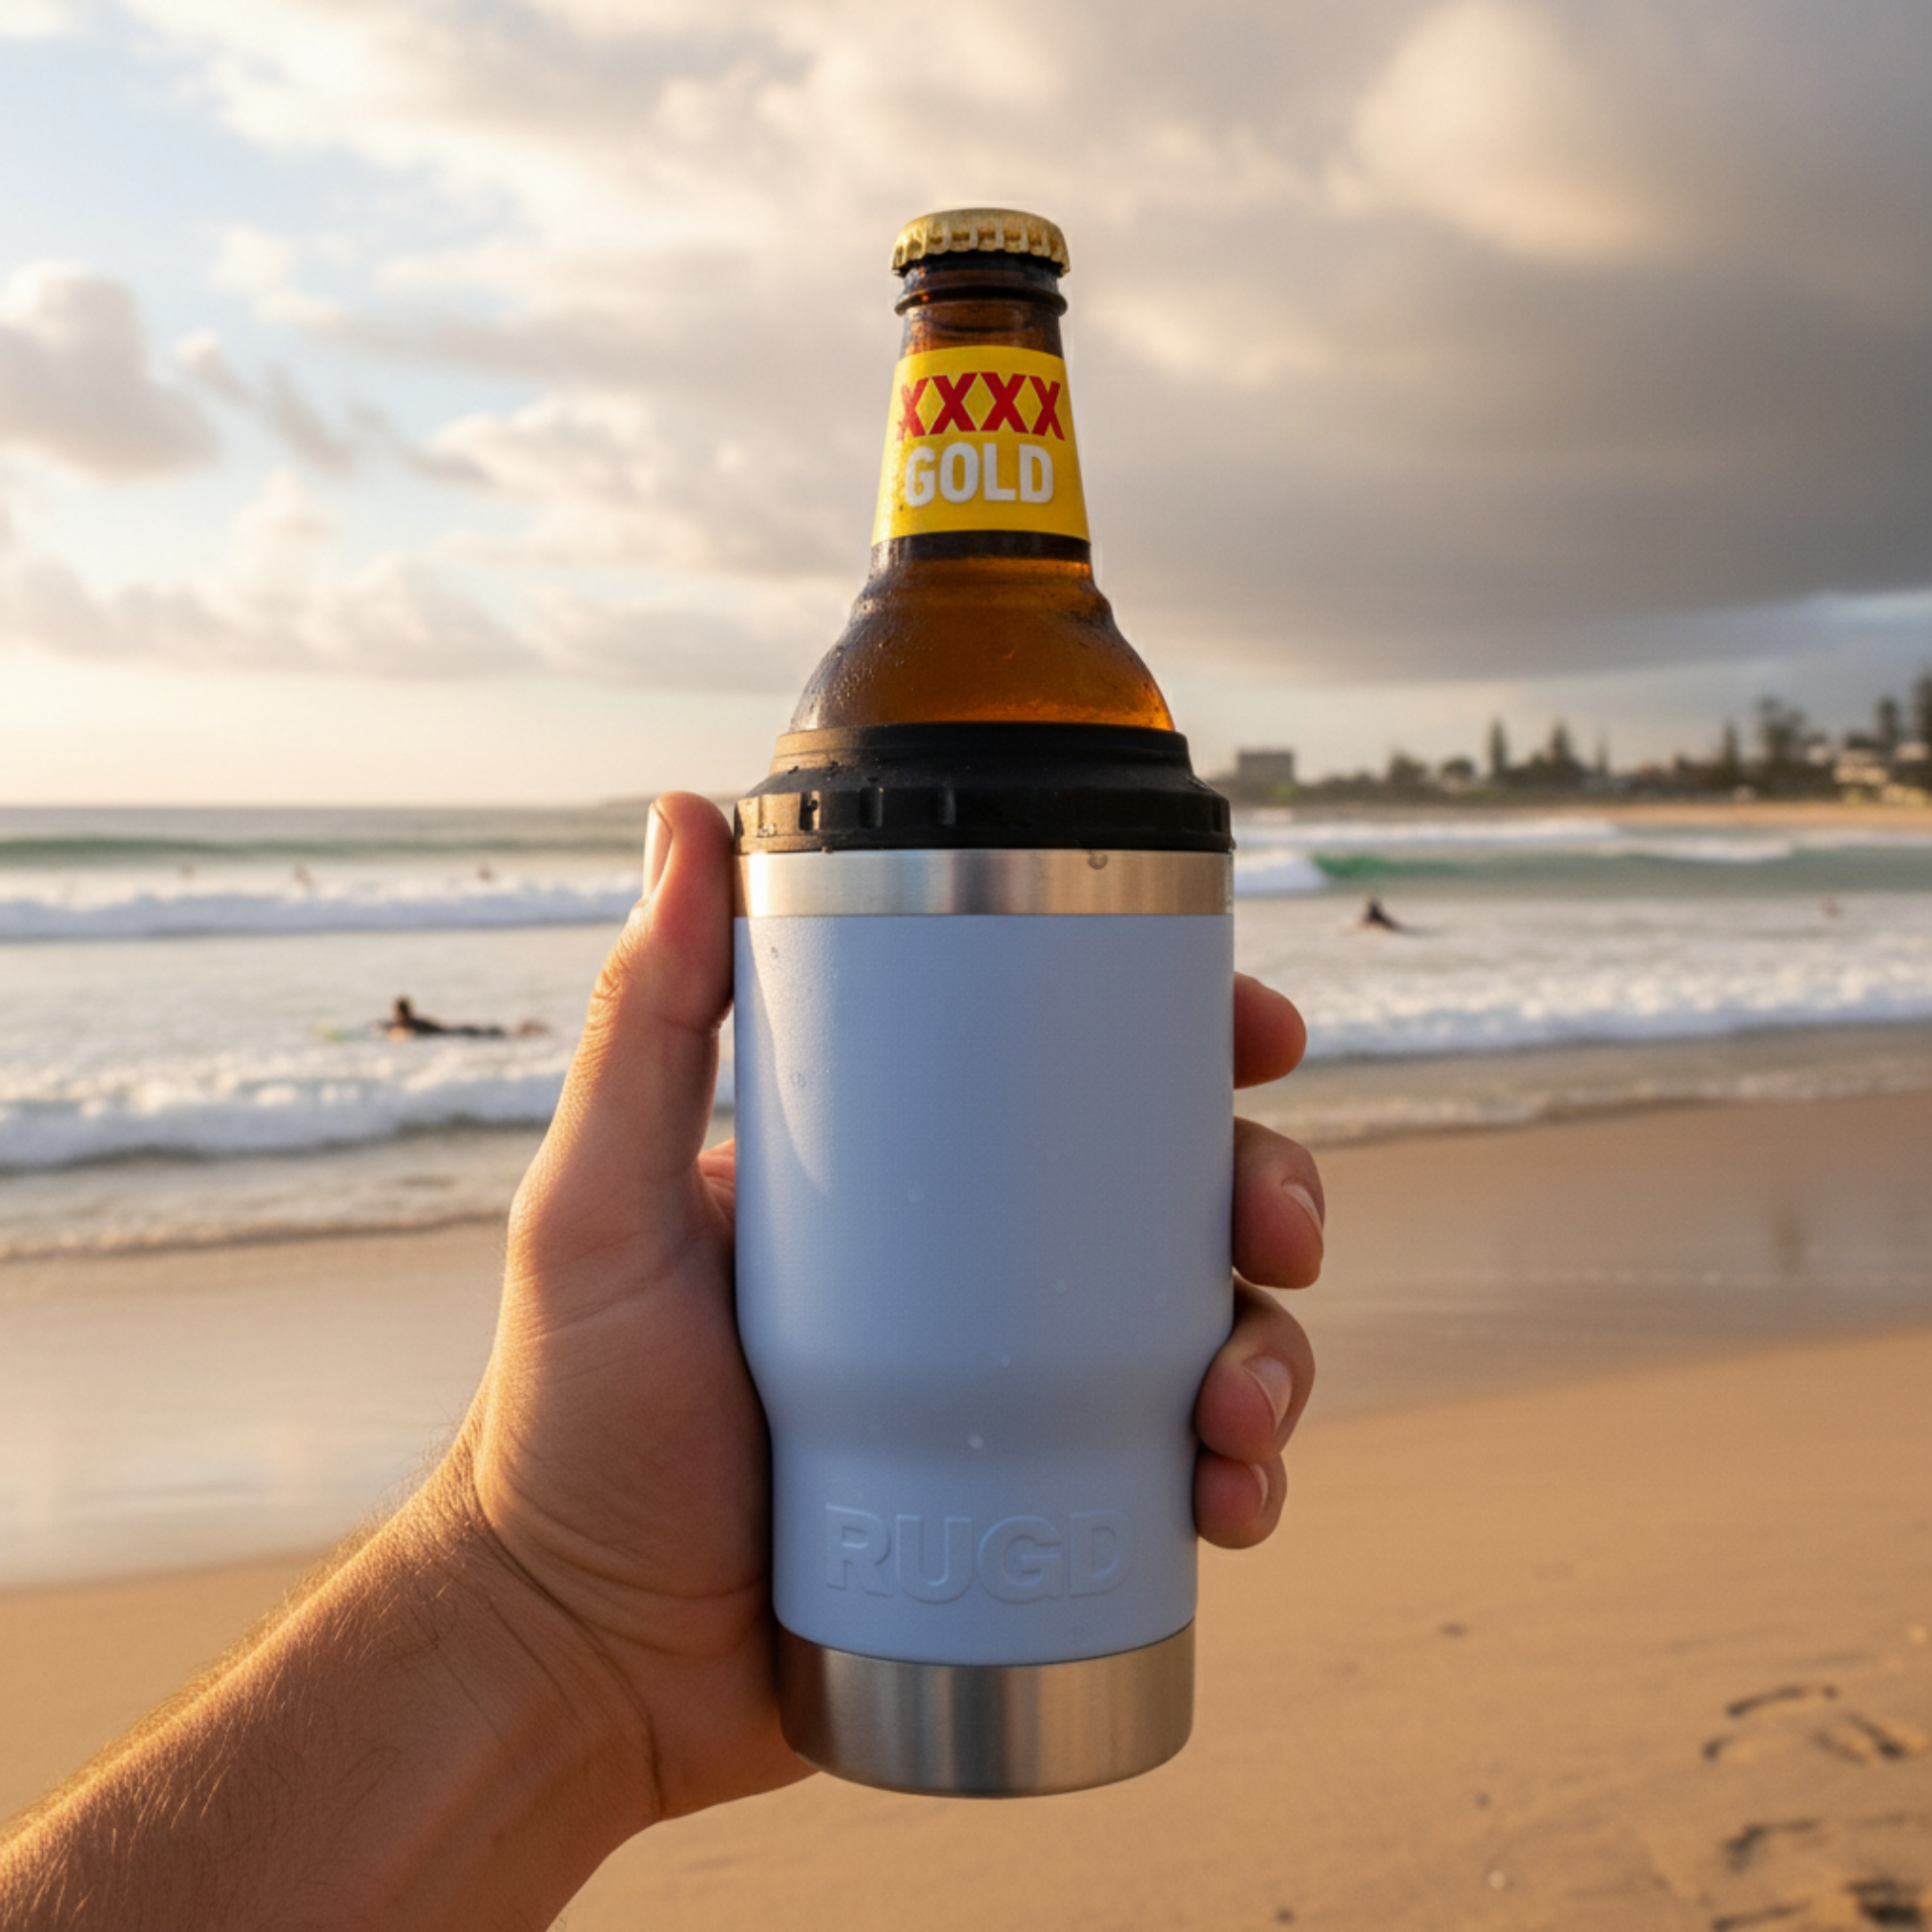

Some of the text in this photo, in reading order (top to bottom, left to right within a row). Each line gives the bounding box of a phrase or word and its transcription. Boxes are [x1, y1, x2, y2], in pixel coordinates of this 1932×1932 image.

[897, 372, 1065, 441] XXXX
[905, 442, 1054, 508] GOLD
[825, 1504, 1133, 1605] RUGD
